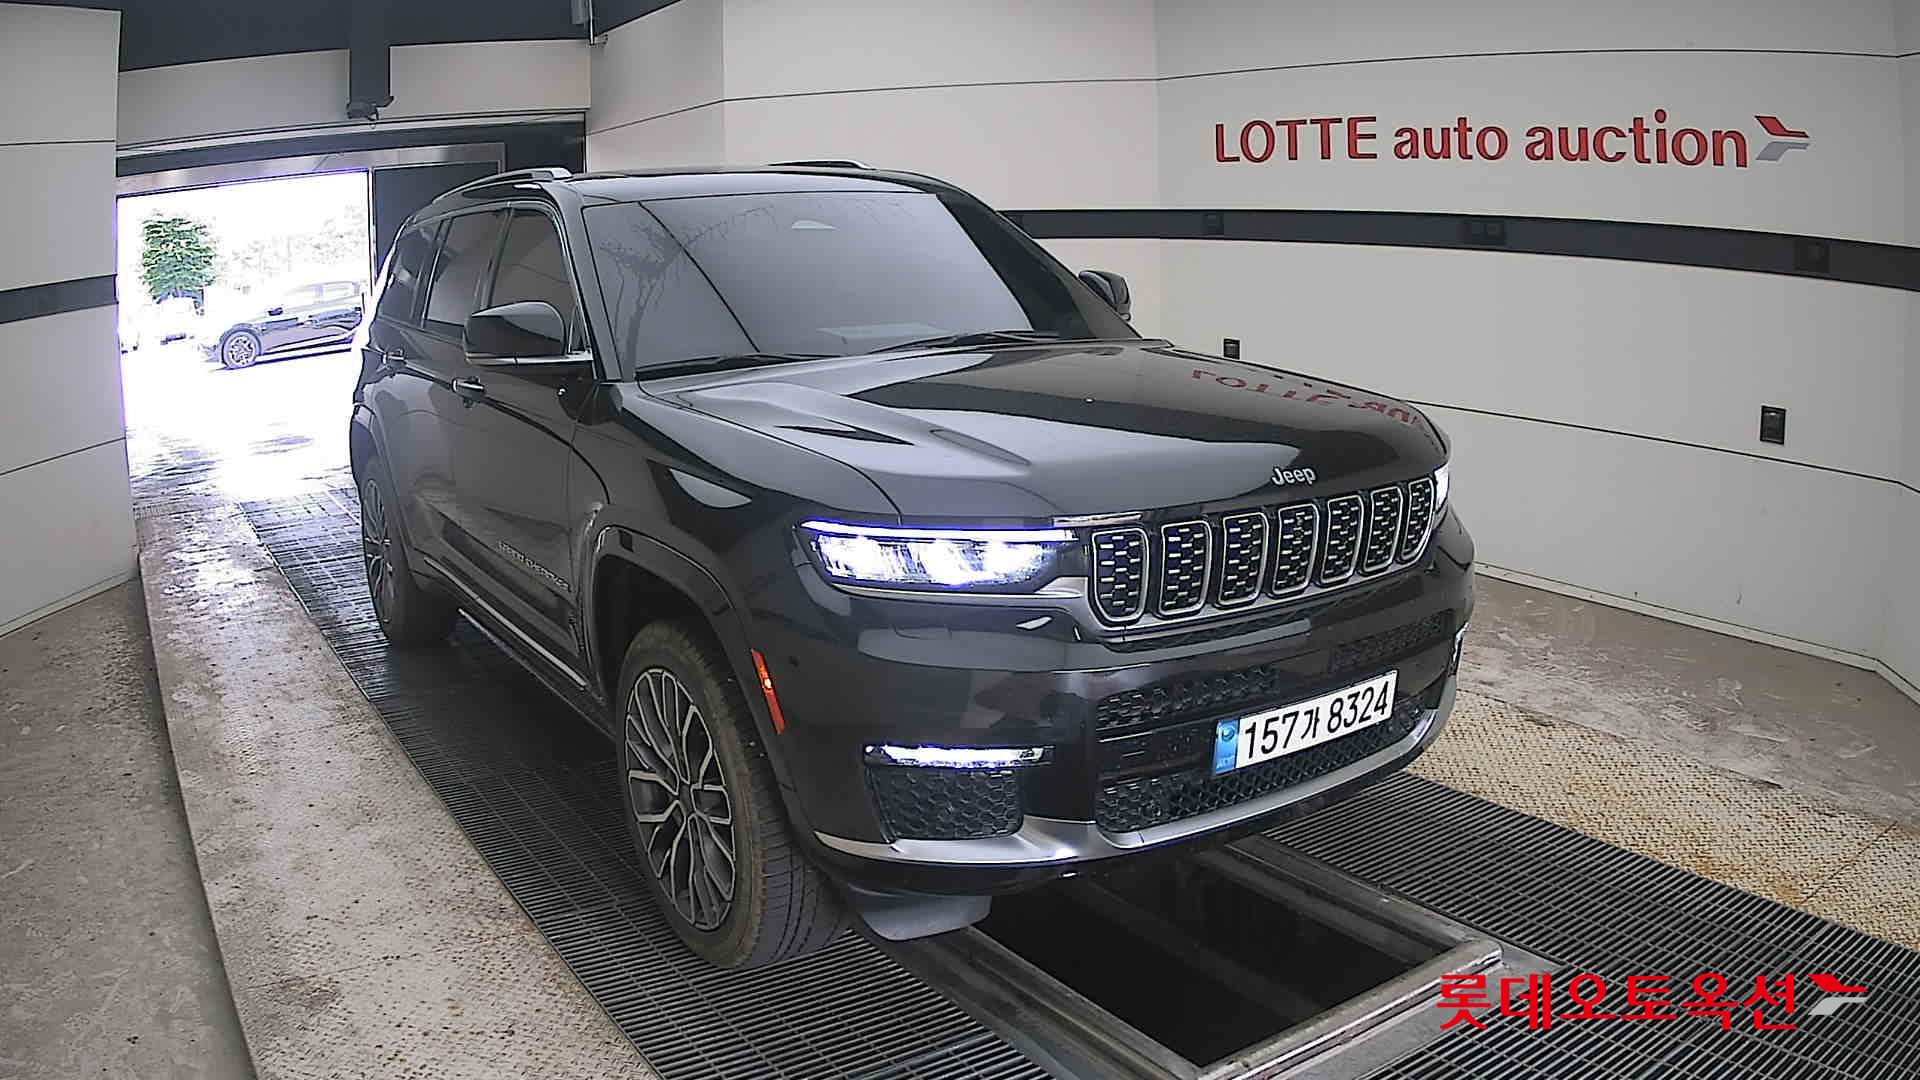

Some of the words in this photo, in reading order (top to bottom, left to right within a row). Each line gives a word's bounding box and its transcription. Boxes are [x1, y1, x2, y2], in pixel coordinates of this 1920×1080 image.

[1215, 116, 1378, 163] LOTTE
[1393, 117, 1510, 161] auto
[1524, 109, 1748, 168] auction
[1270, 467, 1317, 486] Jeep
[1244, 706, 1321, 760] 157가
[1326, 680, 1389, 734] 8324
